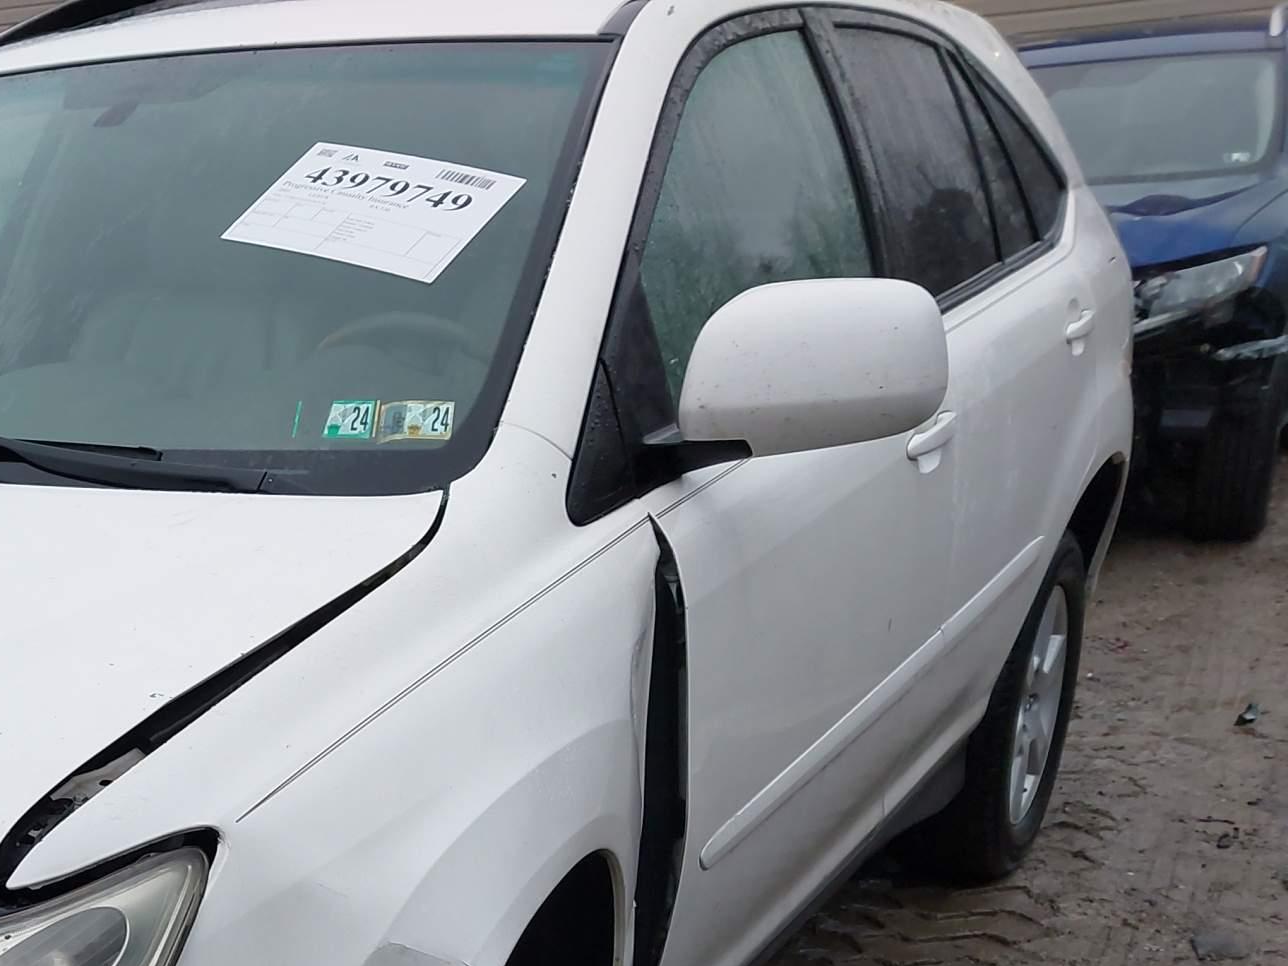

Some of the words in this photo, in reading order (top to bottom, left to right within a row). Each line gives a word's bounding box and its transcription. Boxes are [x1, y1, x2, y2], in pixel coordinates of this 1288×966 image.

[304, 166, 473, 212] 43979749
[350, 406, 369, 432] 24
[431, 406, 450, 432] 24
